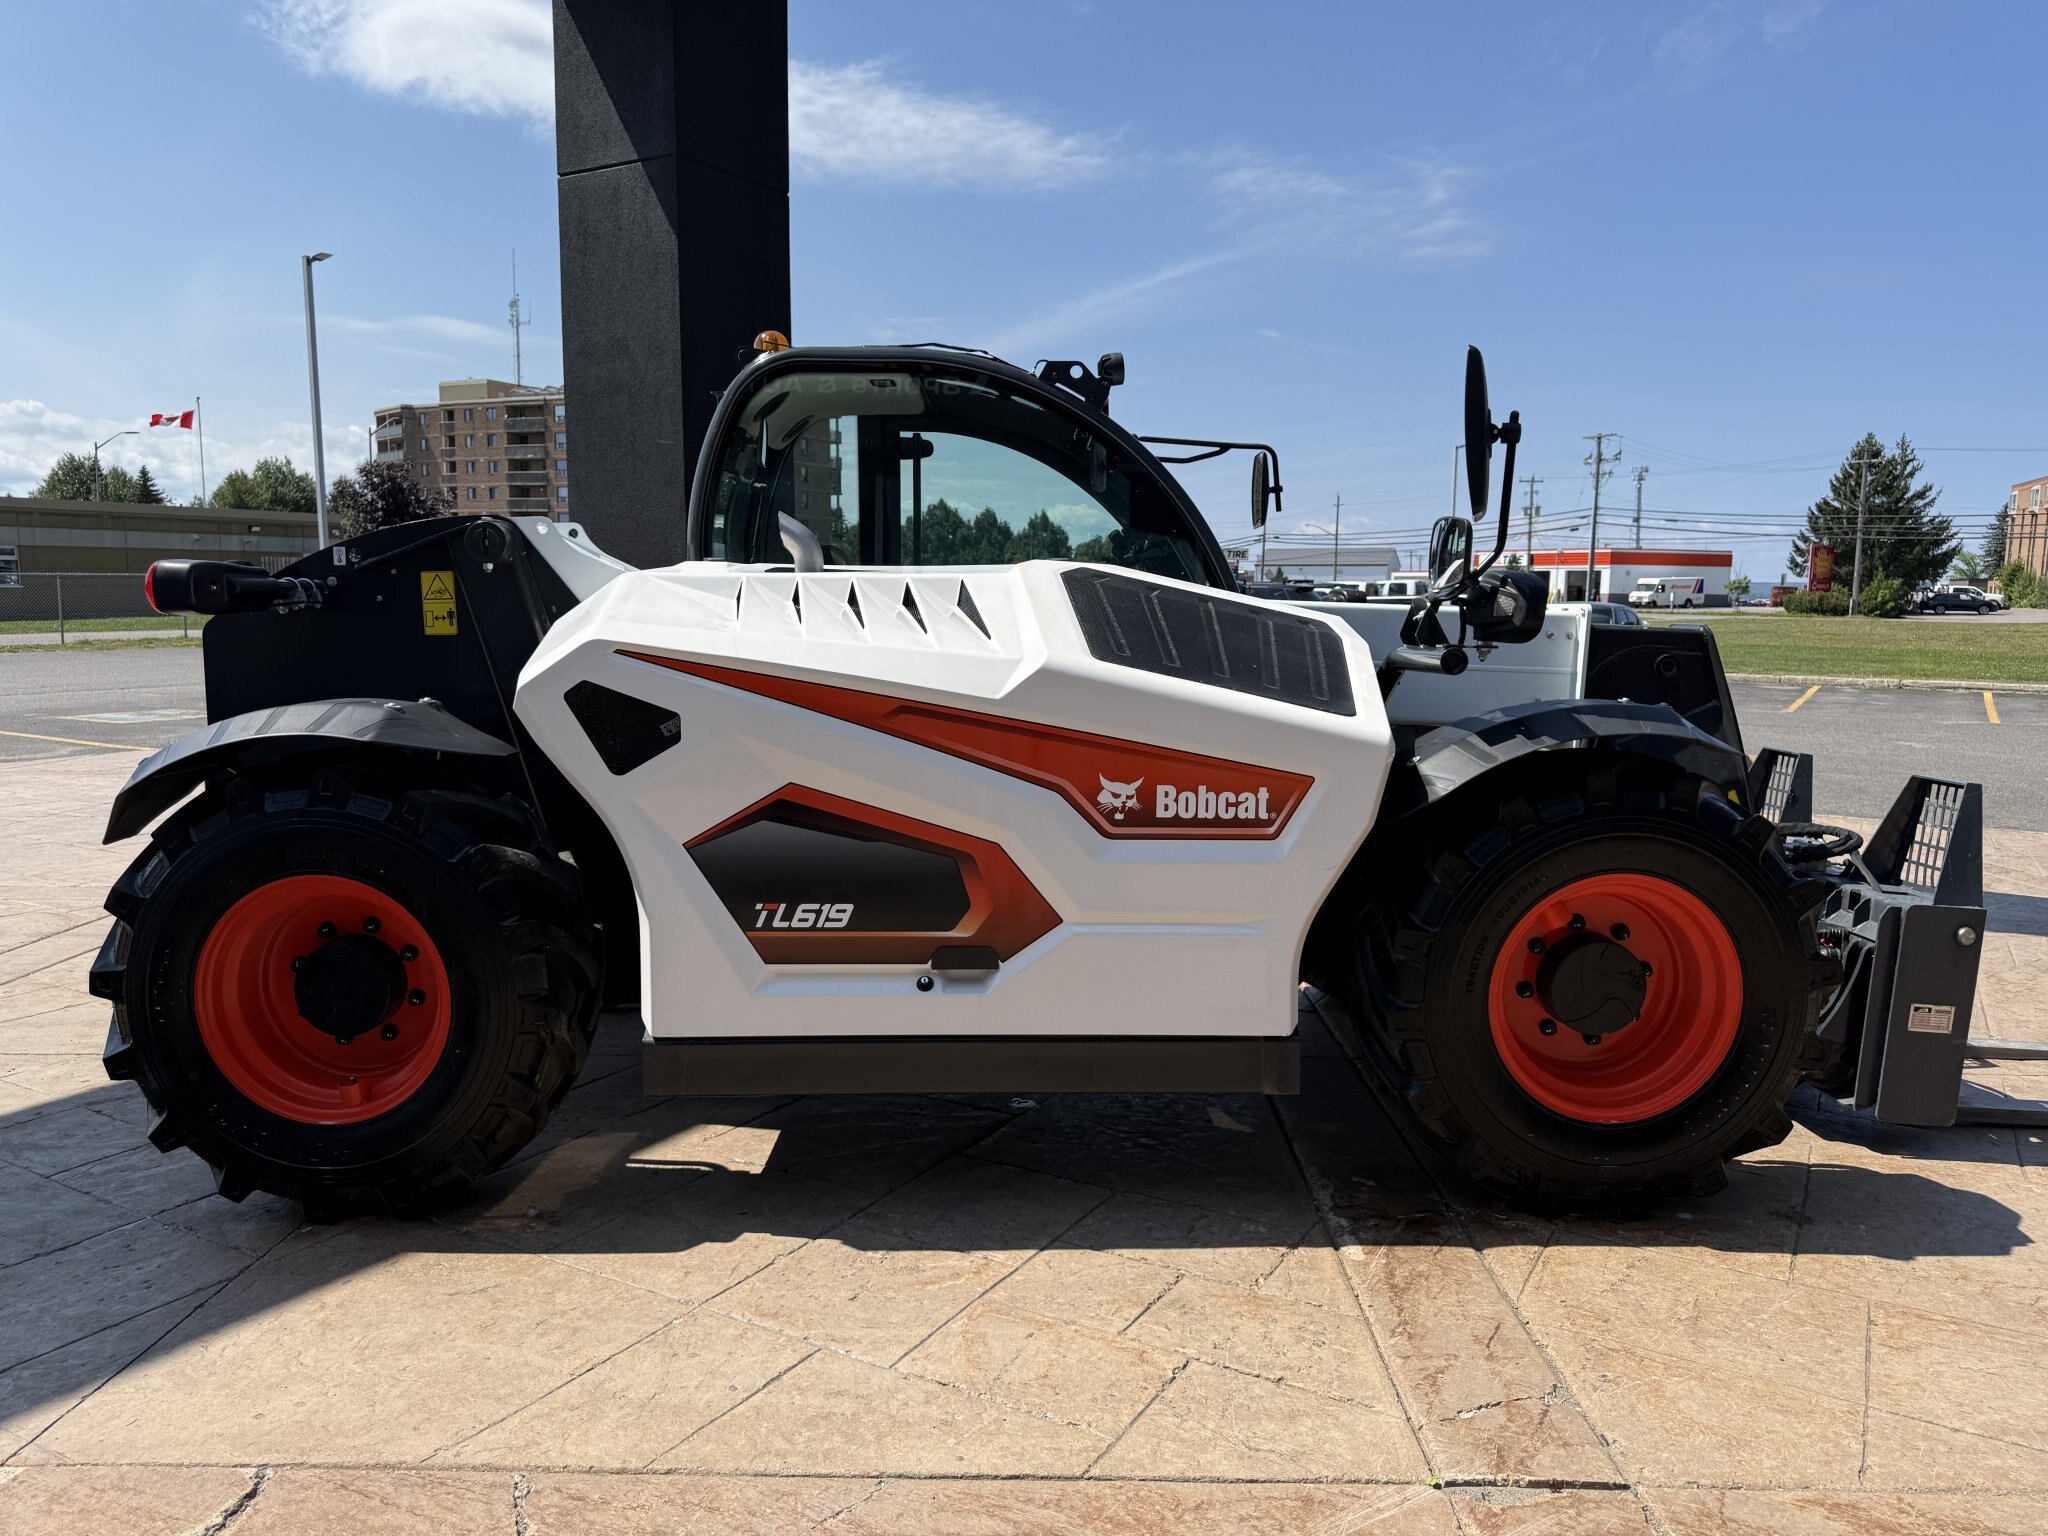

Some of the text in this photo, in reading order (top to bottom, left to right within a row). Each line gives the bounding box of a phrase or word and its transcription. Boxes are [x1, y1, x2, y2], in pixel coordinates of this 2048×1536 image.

[1226, 550, 1248, 559] TIRE
[1503, 555, 1524, 565] TE
[1155, 784, 1270, 820] Bobcat
[754, 903, 855, 928] TL619
[1465, 934, 1491, 994] TRACTION
